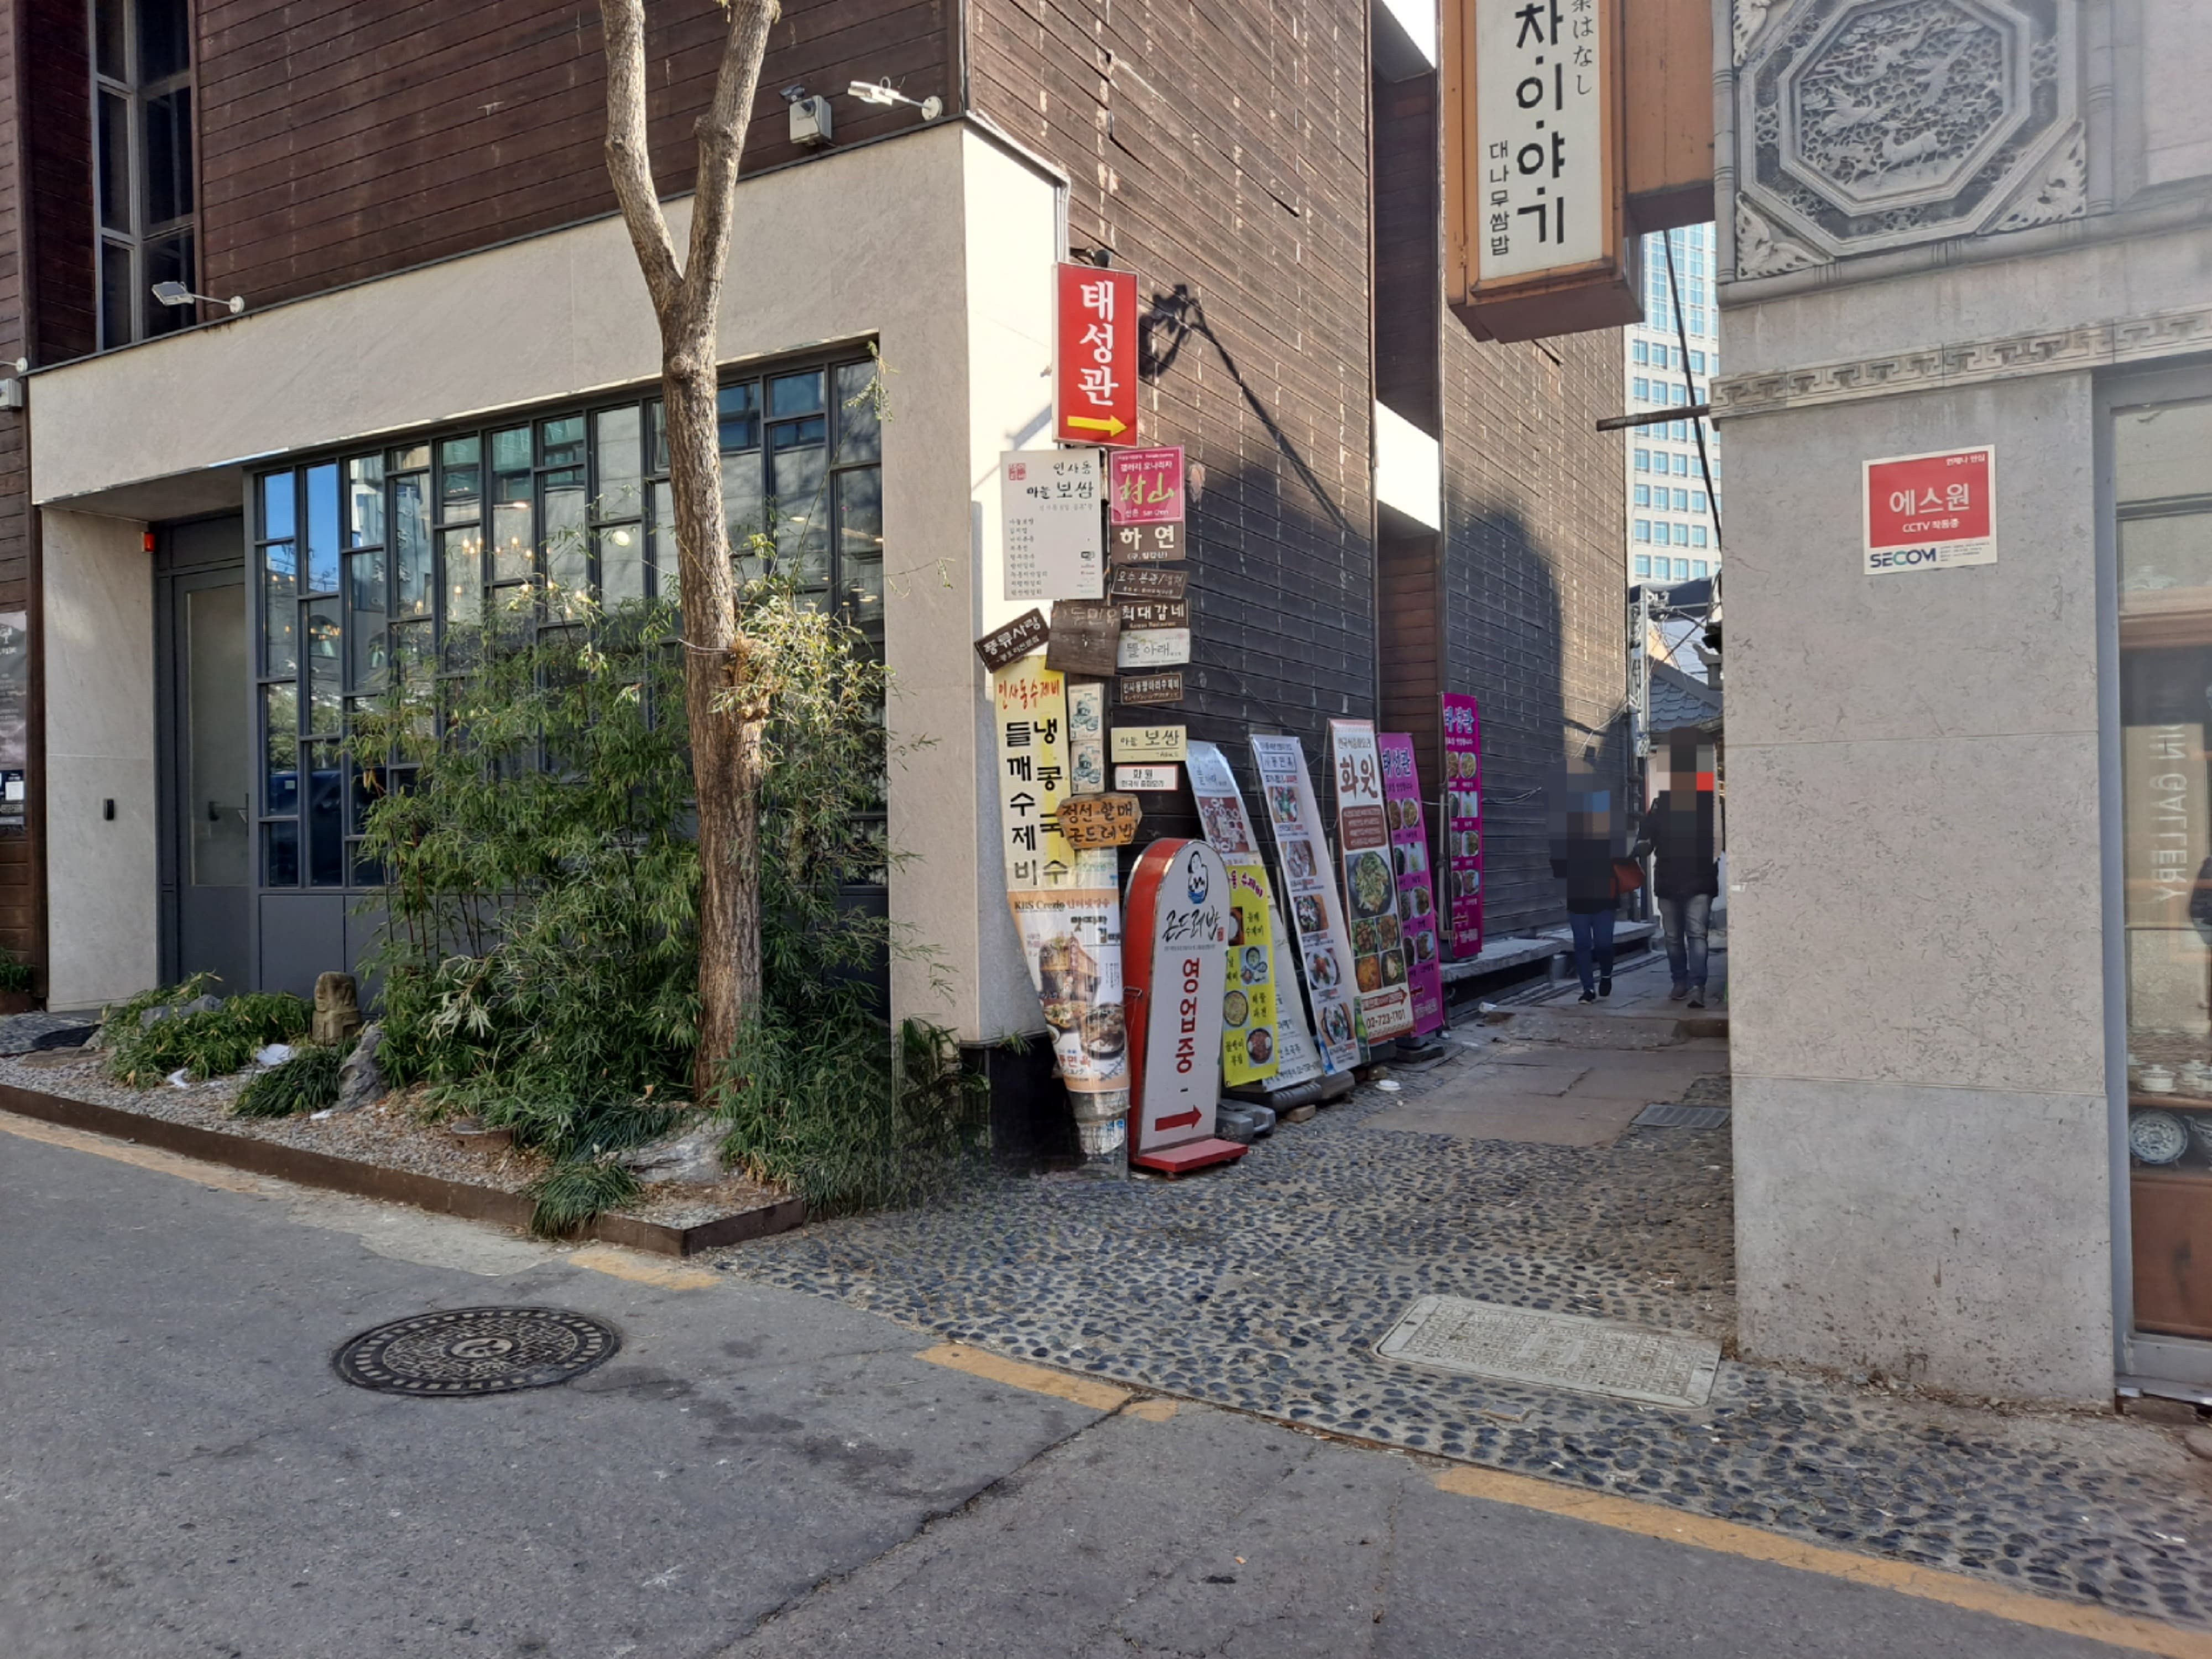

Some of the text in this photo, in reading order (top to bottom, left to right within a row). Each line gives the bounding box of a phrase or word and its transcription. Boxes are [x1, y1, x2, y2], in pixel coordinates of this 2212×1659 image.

[1489, 140, 1510, 256] 대나무쌈밥
[1078, 280, 1119, 406] 태성관
[1053, 461, 1092, 476] 인사동
[1026, 481, 1094, 499] 마늘 보쌈
[1890, 483, 1970, 516] 에스원
[1903, 518, 1959, 533] CCTV 작동중
[1870, 547, 1937, 568] SECOM
[1063, 804, 1092, 823] 정선
[1175, 957, 1200, 1074] 영업중
